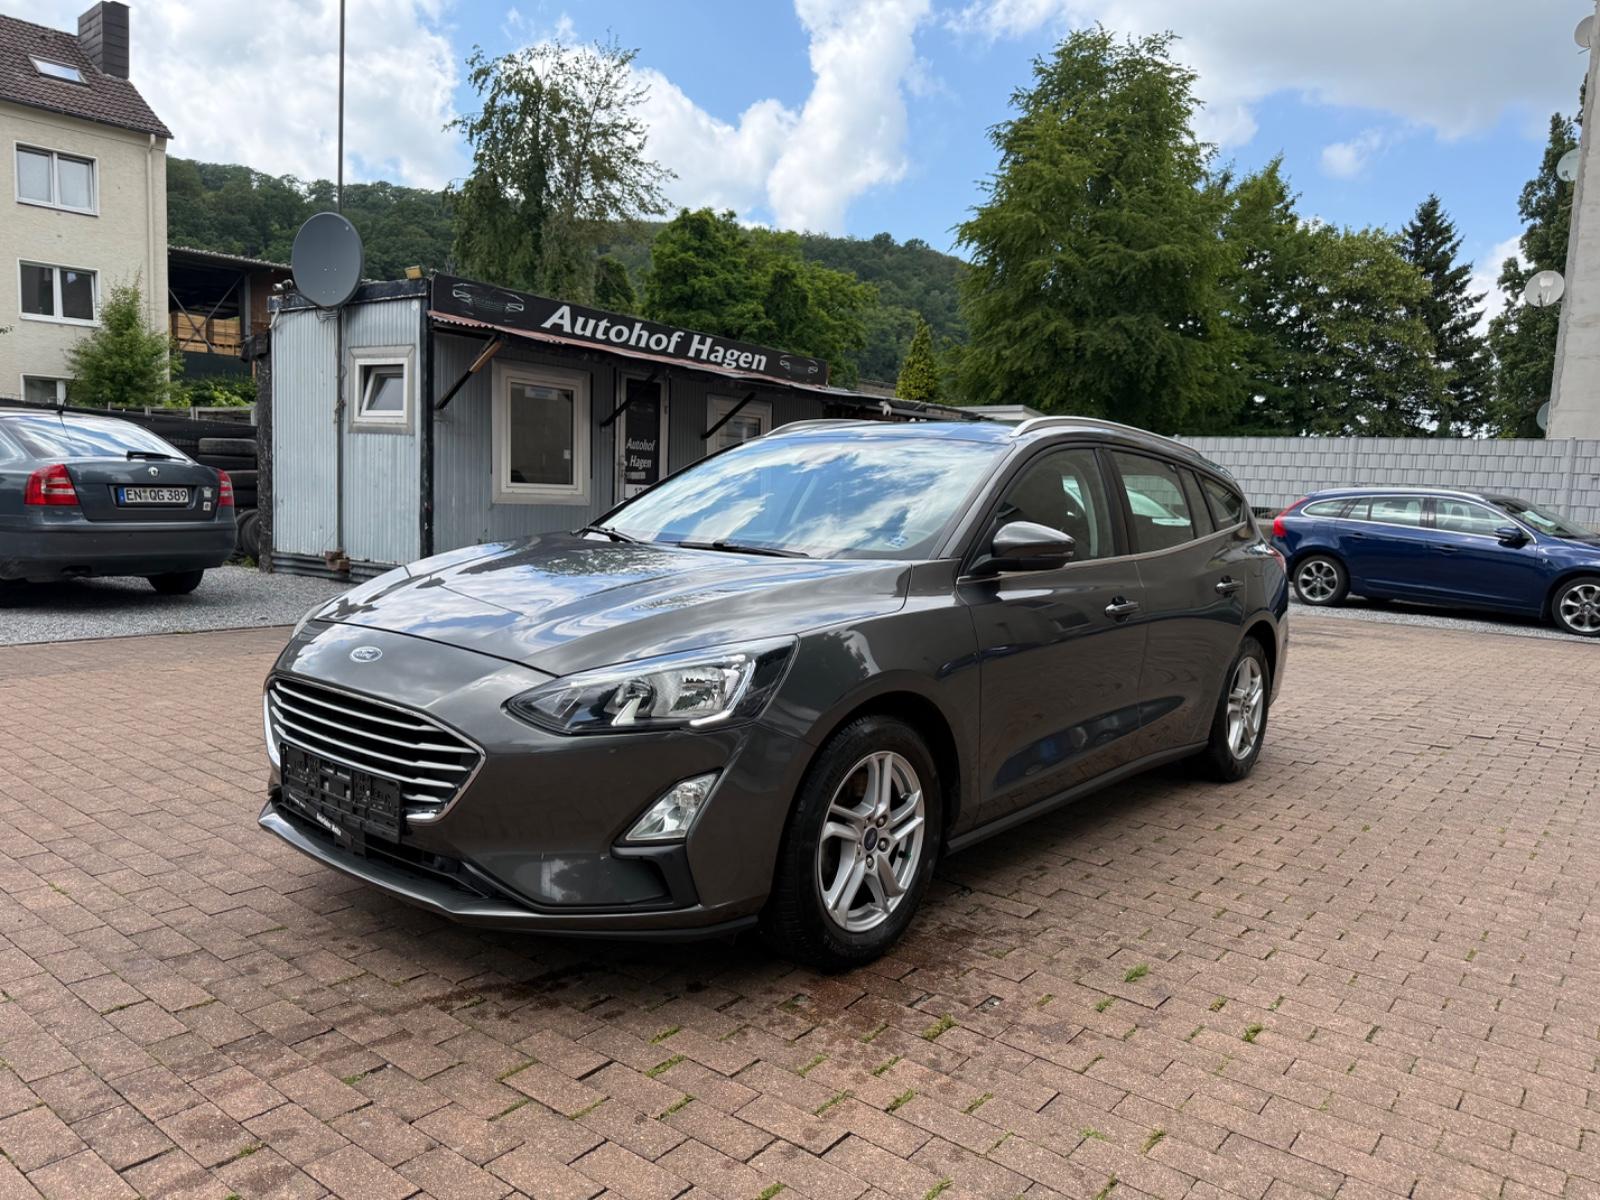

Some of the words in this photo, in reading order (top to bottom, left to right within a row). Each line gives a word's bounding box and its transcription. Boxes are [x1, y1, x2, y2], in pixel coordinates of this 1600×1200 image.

[541, 304, 684, 353] Autohof
[687, 334, 768, 371] Hagen
[626, 437, 656, 451] Autohof
[630, 455, 652, 470] Hagen
[125, 488, 142, 501] EN
[149, 488, 165, 501] QG
[166, 489, 187, 501] 389
